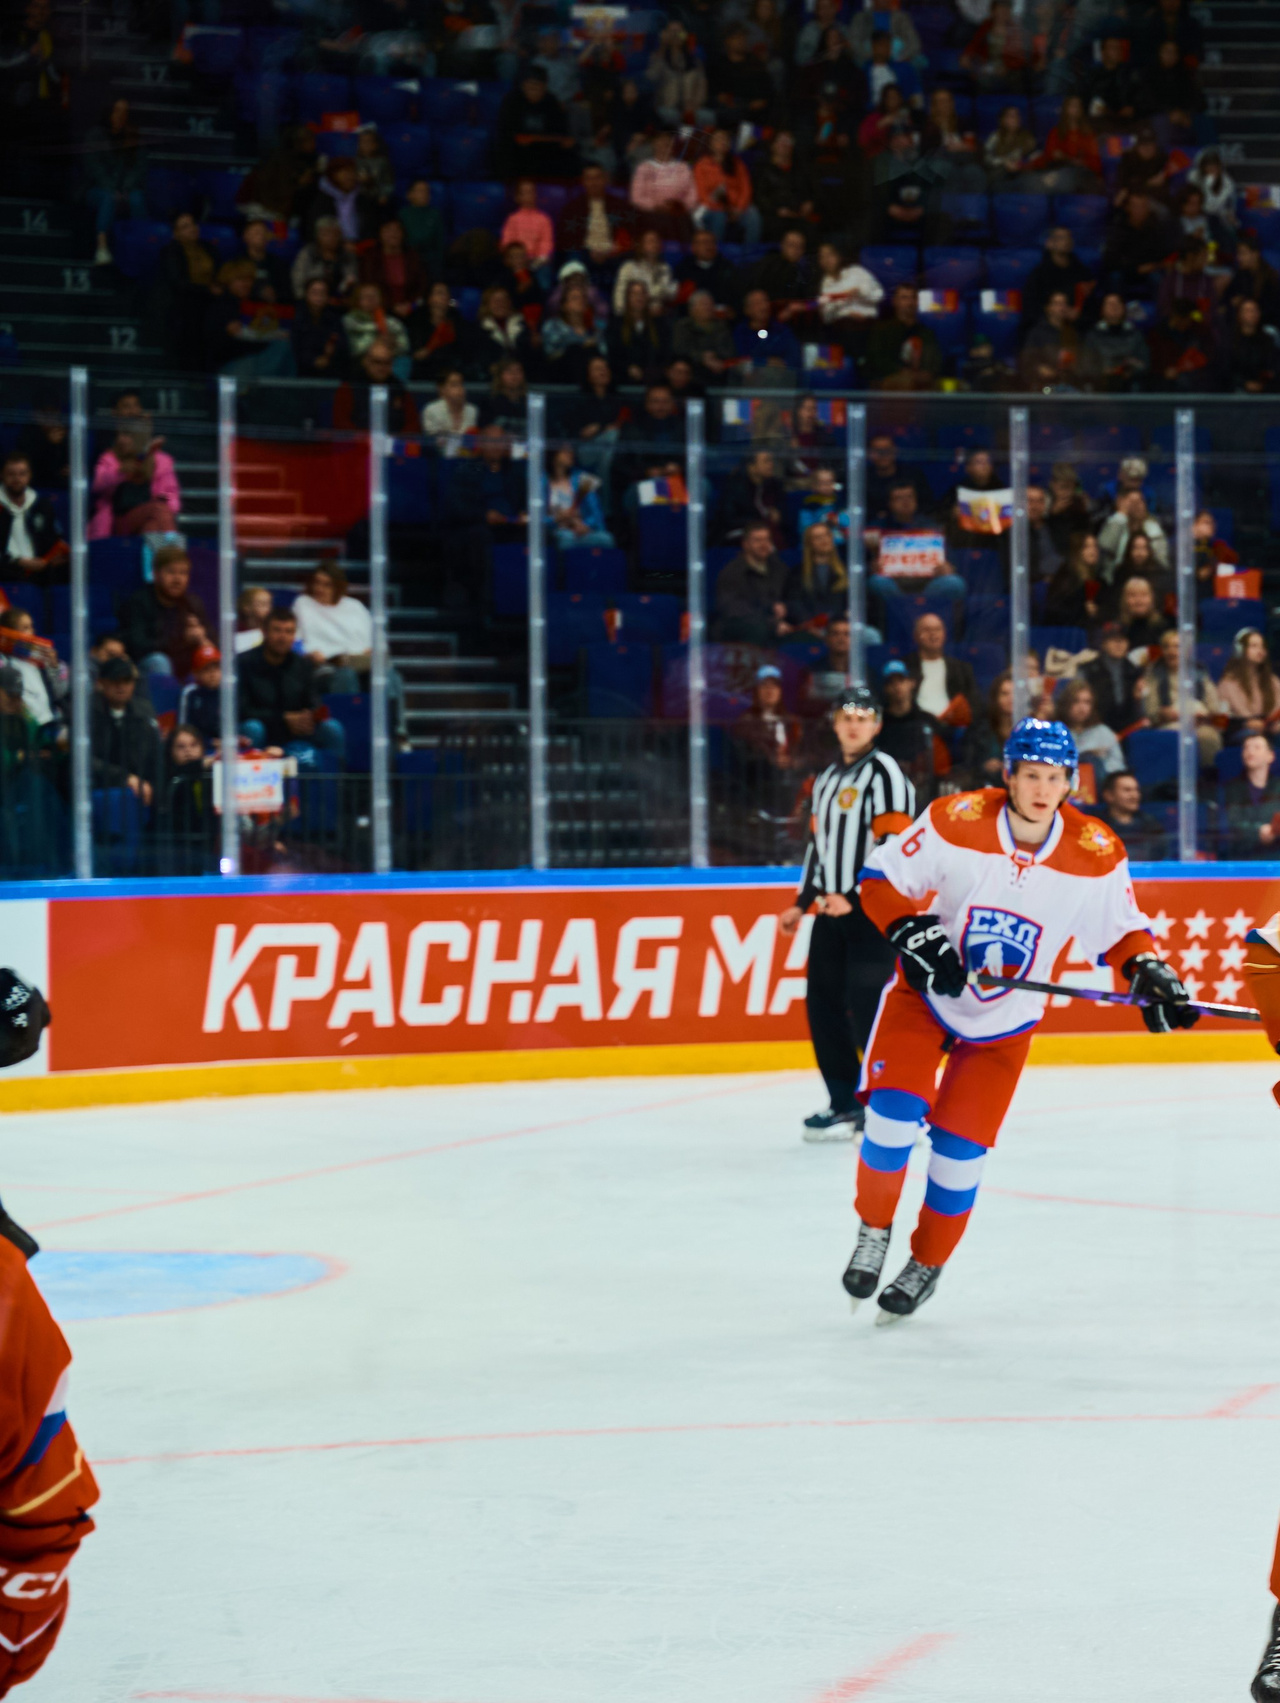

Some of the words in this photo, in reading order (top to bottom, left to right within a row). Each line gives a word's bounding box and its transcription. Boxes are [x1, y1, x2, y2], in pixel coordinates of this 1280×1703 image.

[22, 208, 48, 232] 14
[62, 267, 90, 292] 13
[108, 325, 138, 350] 12
[157, 388, 180, 412] 11
[202, 916, 684, 1033] КРАСНАЯ
